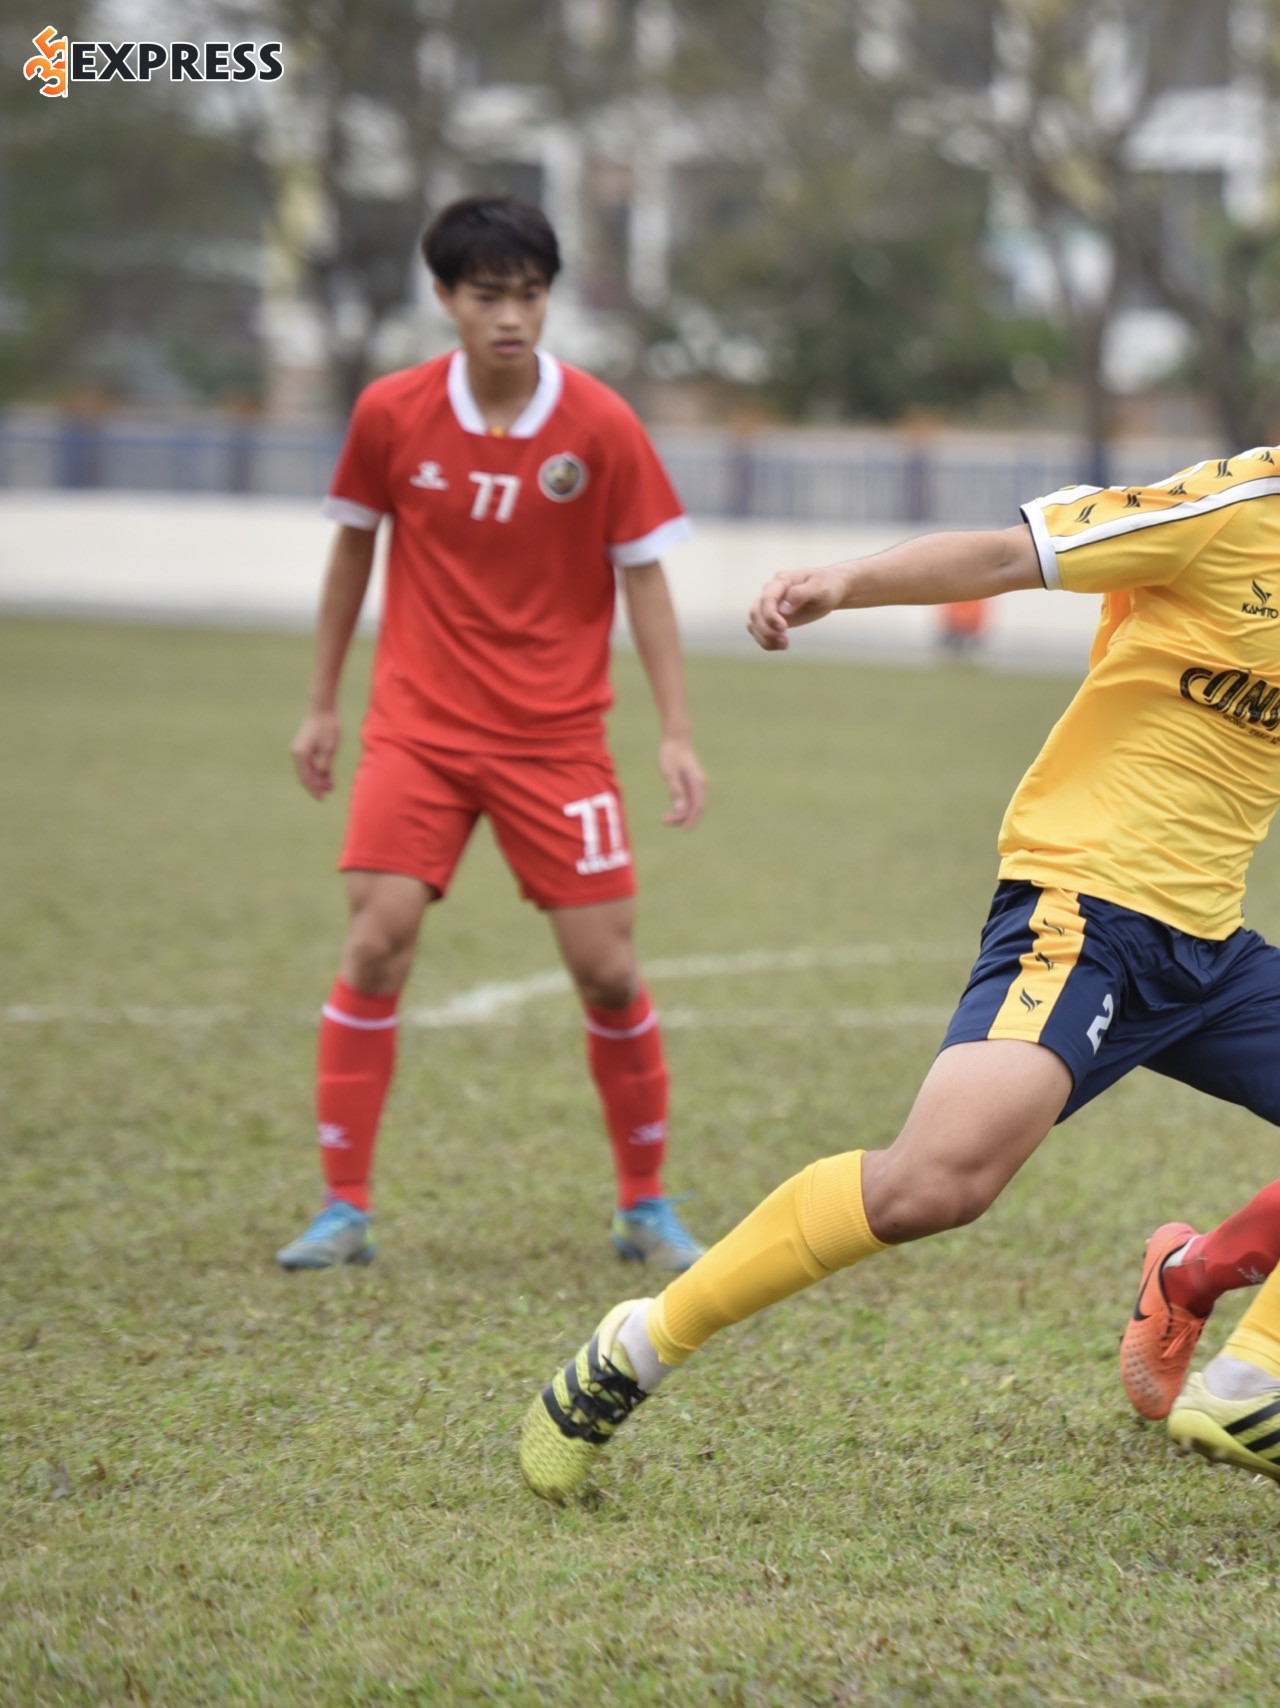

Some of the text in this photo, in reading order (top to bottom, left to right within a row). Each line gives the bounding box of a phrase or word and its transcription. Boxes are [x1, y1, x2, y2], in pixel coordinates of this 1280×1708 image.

[468, 470, 521, 523] 77
[1241, 602, 1279, 619] KAMITO
[562, 791, 622, 859] 77
